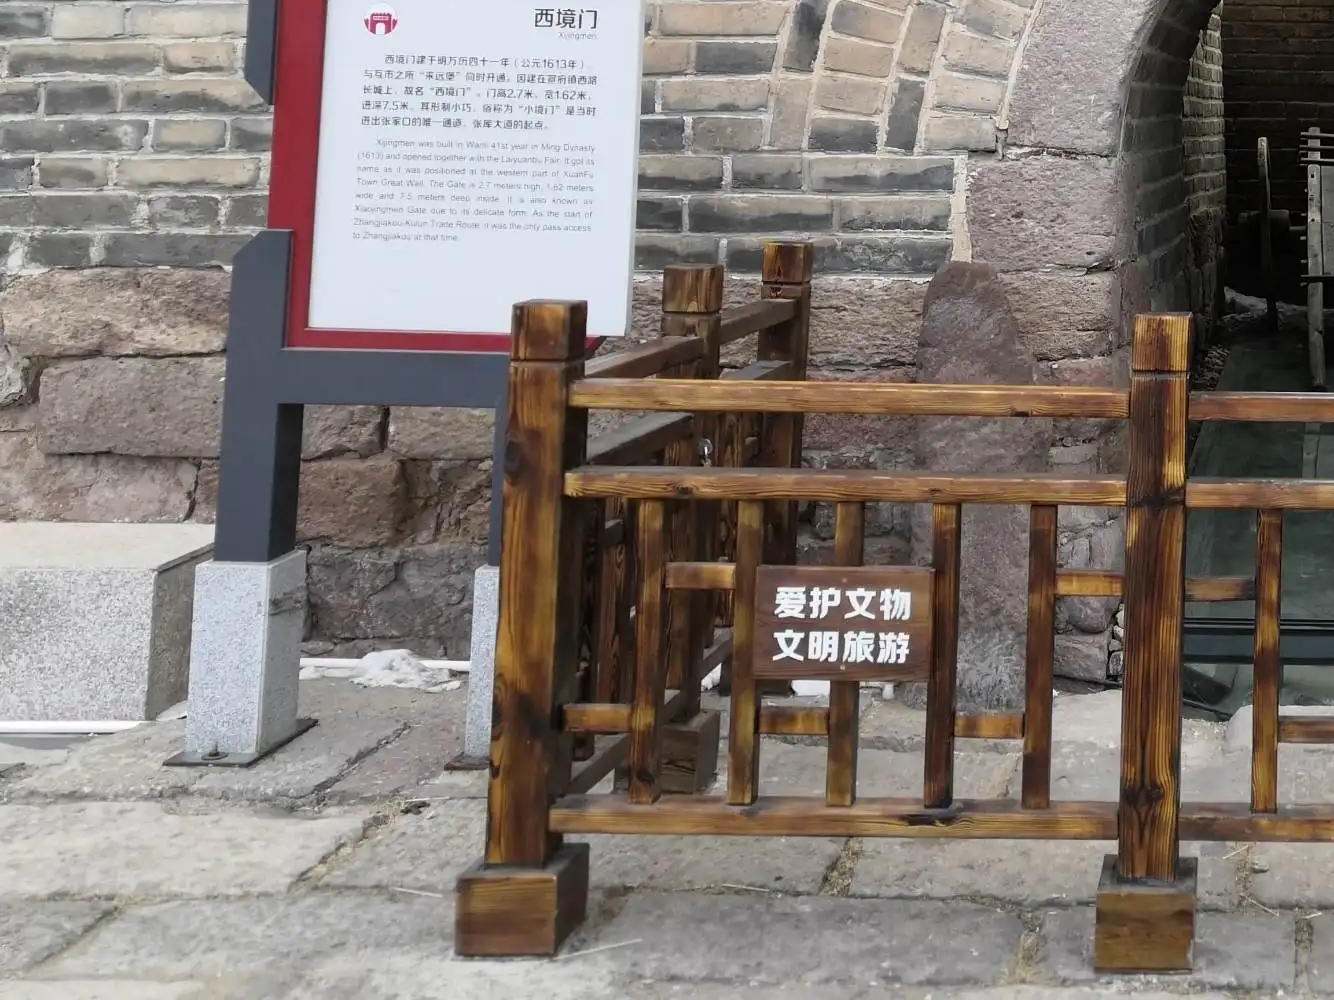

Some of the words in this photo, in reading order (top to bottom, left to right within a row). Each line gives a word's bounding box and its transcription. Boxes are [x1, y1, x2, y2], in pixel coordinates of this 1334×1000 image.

[533, 7, 598, 30] 西境门
[491, 141, 509, 150] 41st
[510, 143, 528, 152] year
[541, 143, 561, 153] Ming
[563, 143, 595, 154] Dynasty
[357, 151, 384, 161] (1613)
[386, 151, 400, 160] and
[402, 152, 432, 163] opened
[434, 153, 467, 164] together
[486, 154, 499, 163] the
[424, 166, 466, 177] positioned
[480, 167, 494, 176] the
[496, 168, 528, 177] western
[532, 169, 548, 179] part
[357, 177, 378, 186] Town
[381, 178, 403, 187] Great
[430, 179, 444, 188] The
[446, 180, 466, 189] Gate
[566, 183, 594, 192] meters
[355, 190, 373, 199] wide
[378, 191, 394, 200] and
[417, 192, 445, 201] meters
[450, 193, 470, 204] deep
[552, 196, 578, 205] known
[407, 205, 426, 214] Gate
[430, 206, 446, 214] due
[474, 207, 505, 216] delicate
[547, 209, 560, 218] the
[563, 210, 581, 218] start
[430, 219, 454, 228] Trade
[509, 222, 522, 230] the
[523, 222, 540, 232] only
[542, 224, 561, 233] pass
[774, 586, 912, 621] 爱护文物
[772, 629, 910, 664] 文明旅游
